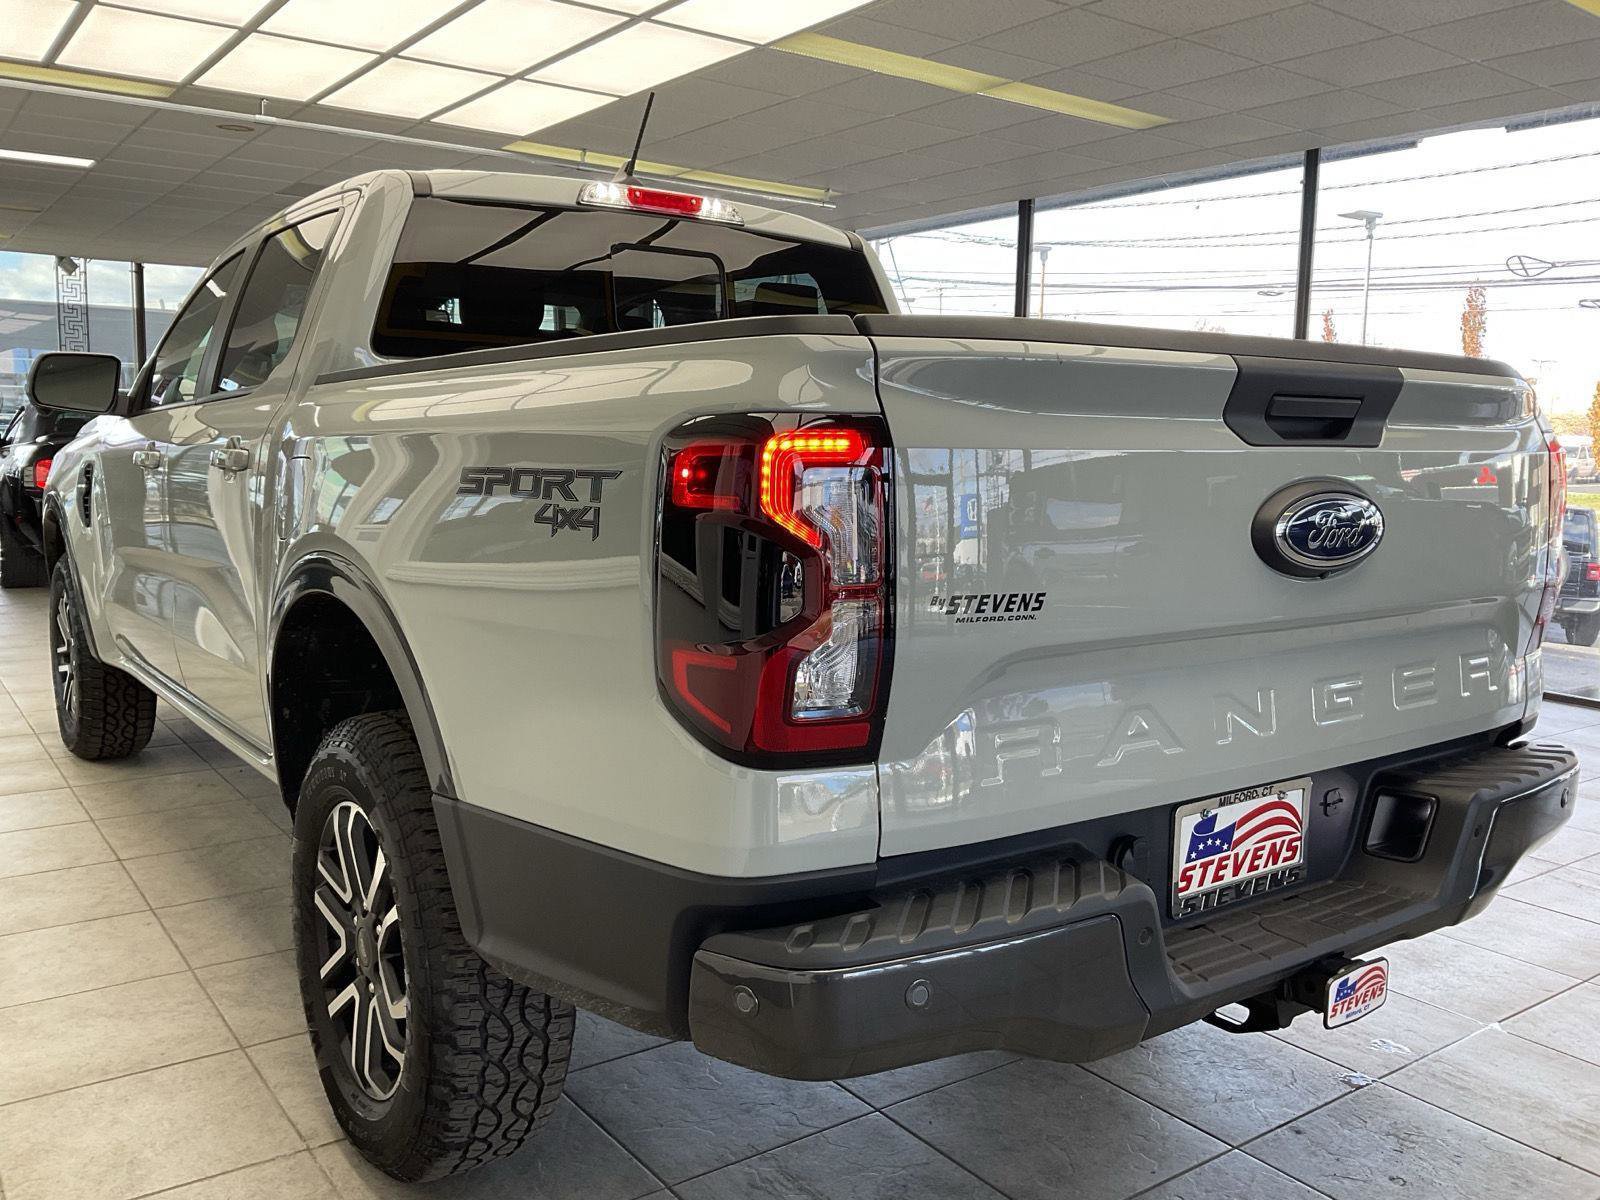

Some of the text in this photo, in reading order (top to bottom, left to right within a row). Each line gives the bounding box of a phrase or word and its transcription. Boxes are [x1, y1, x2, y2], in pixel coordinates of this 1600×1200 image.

[456, 466, 623, 503] SPORT
[533, 503, 601, 541] 4x4
[1307, 509, 1363, 549] Ford
[929, 592, 1047, 615] By STEVENS
[977, 653, 1499, 788] RANGER
[1261, 785, 1274, 797] CT
[1177, 836, 1303, 893] STEVENS
[1178, 867, 1302, 918] STEVENS
[1329, 982, 1386, 1019] STEVENS
